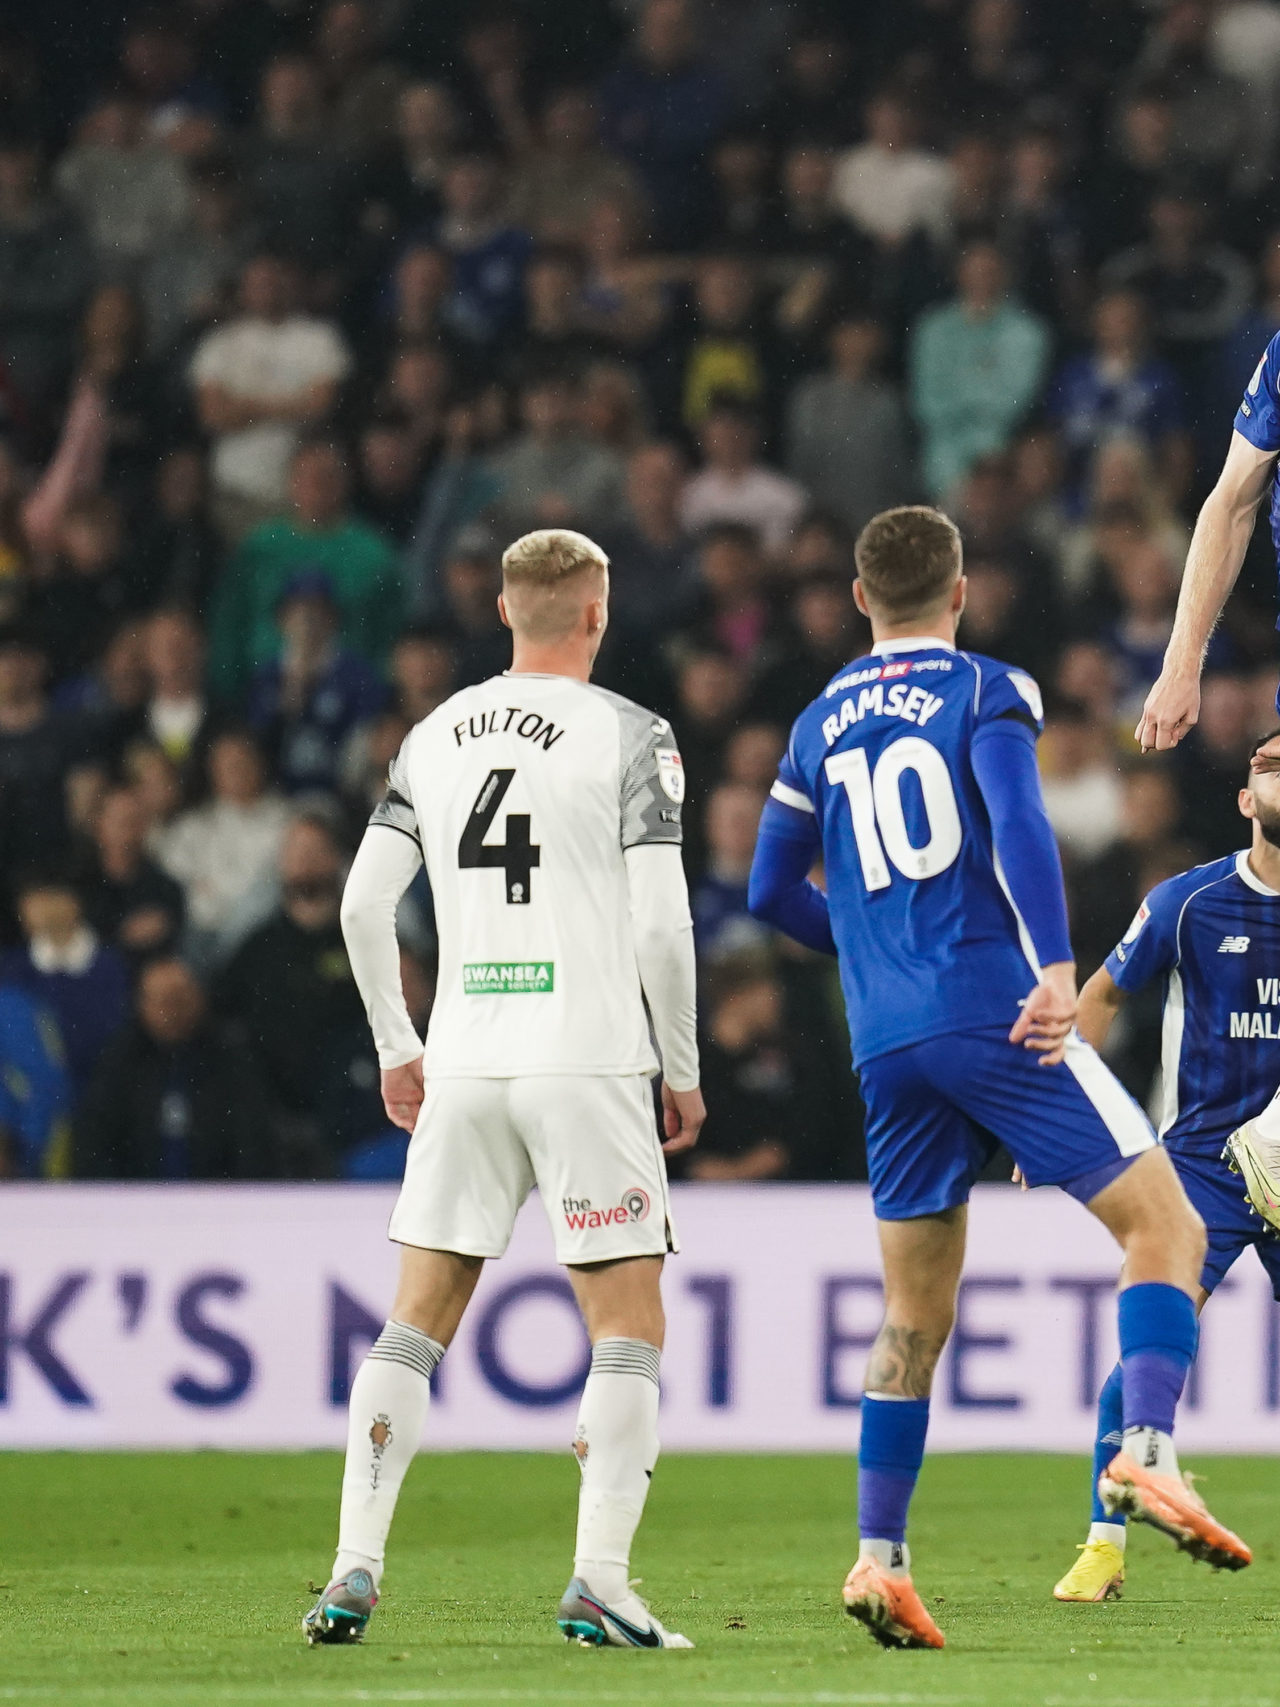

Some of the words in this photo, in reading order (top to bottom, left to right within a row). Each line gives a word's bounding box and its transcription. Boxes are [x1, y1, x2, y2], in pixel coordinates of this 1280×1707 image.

[453, 707, 564, 751] FULTON
[822, 684, 944, 747] RAMSEY
[458, 768, 540, 904] 4
[824, 736, 962, 892] 10
[463, 966, 549, 982] SWANSEA
[562, 1197, 591, 1213] the
[565, 1206, 628, 1230] wave
[0, 1272, 253, 1407] K'S
[330, 1276, 732, 1408] NO1
